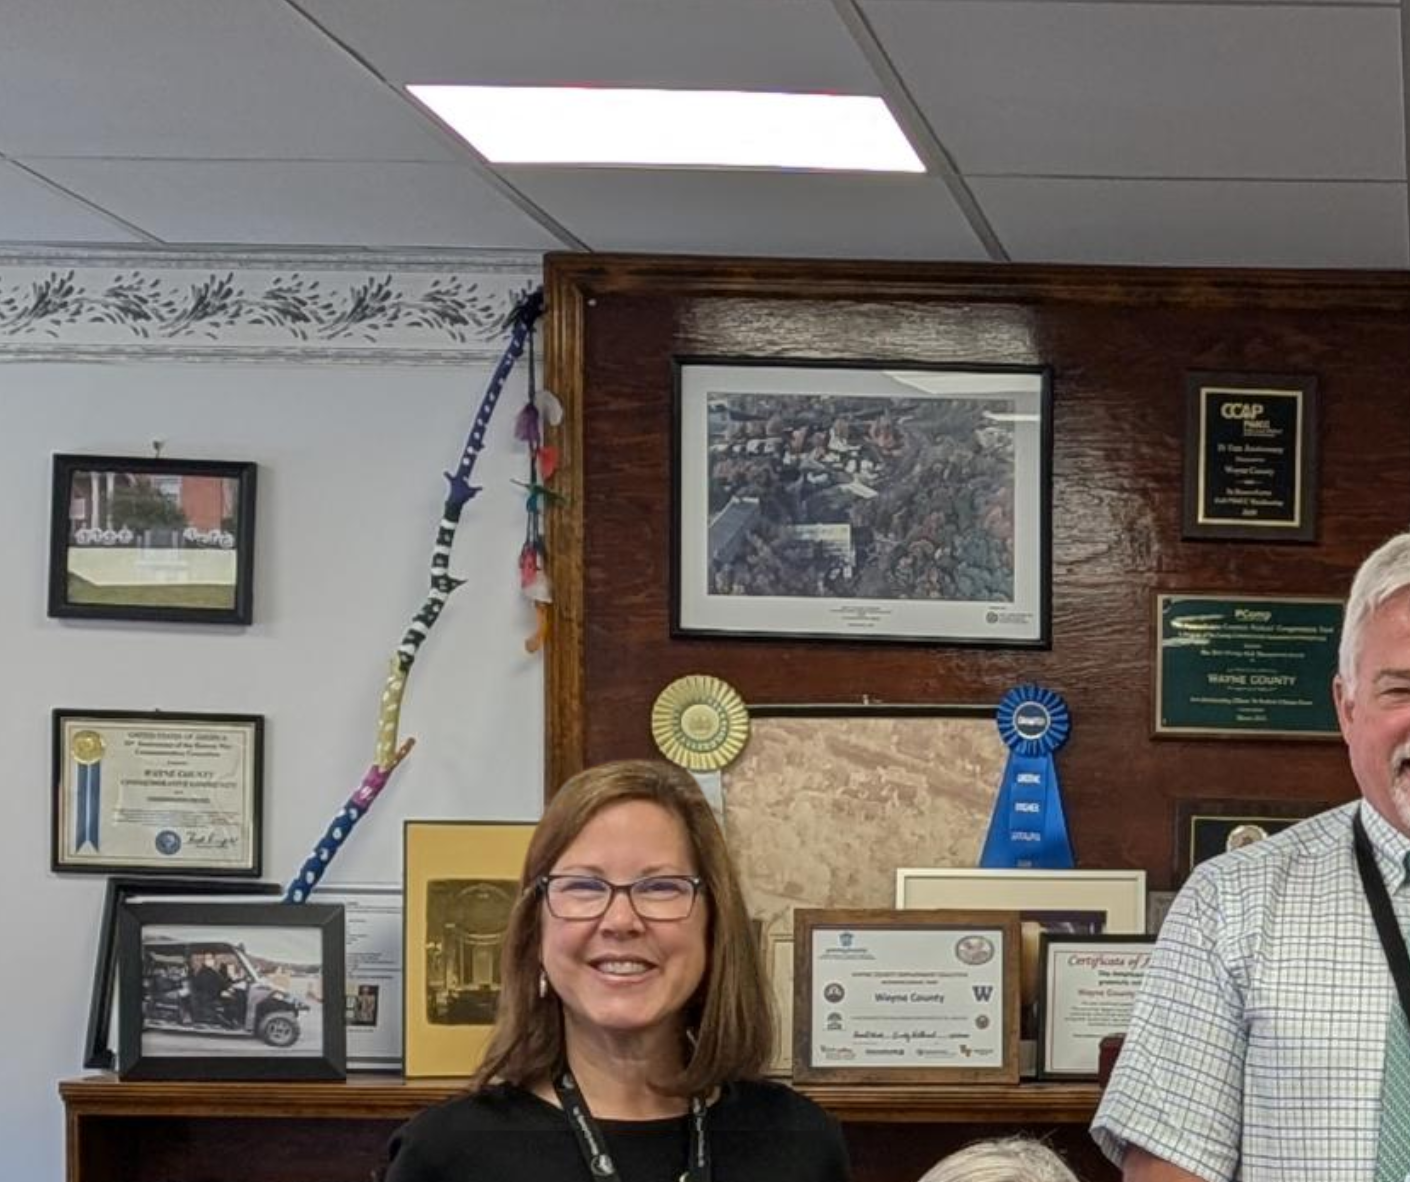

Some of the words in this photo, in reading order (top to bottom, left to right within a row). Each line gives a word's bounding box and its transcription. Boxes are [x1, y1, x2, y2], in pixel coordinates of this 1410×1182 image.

[1220, 403, 1264, 419] CCAP
[1207, 673, 1247, 685] WAYNE
[1250, 675, 1297, 686] COUNTY
[1067, 954, 1125, 969] Certificate
[1128, 953, 1140, 970] of
[874, 992, 908, 1004] Wayne
[910, 992, 945, 1005] County
[972, 985, 993, 1003] W
